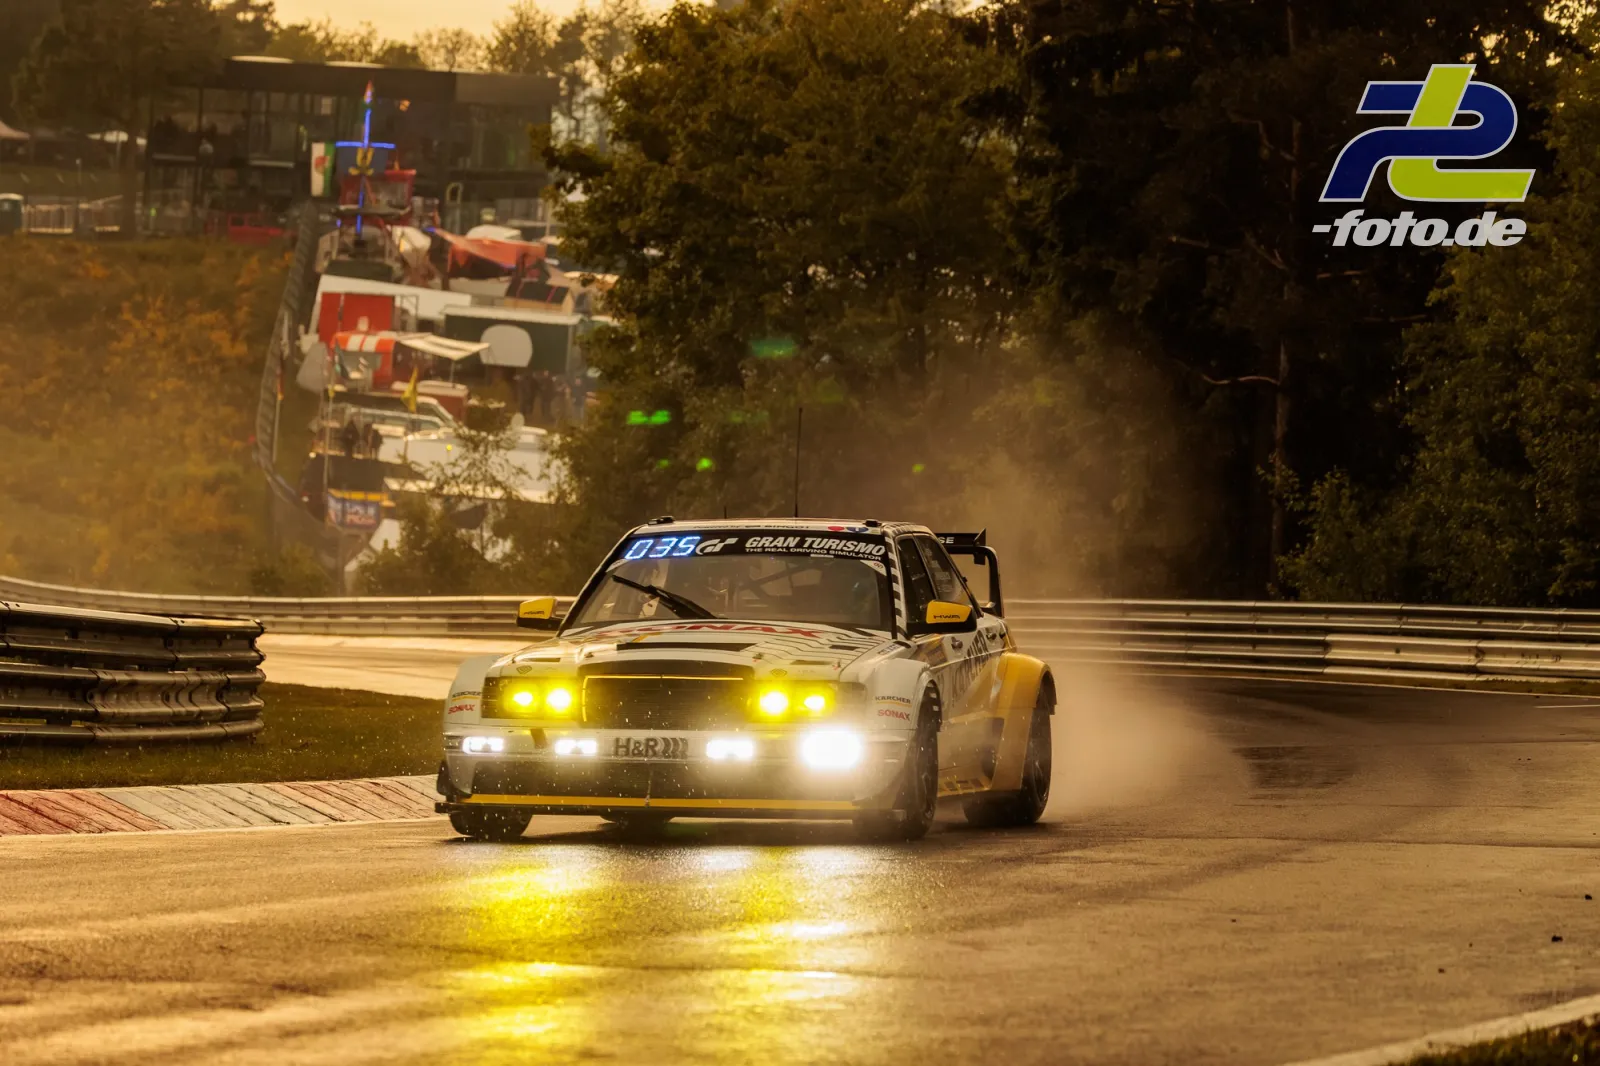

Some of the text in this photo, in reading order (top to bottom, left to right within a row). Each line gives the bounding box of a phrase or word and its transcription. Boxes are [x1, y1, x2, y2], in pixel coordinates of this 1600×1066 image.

[624, 536, 701, 560] 035
[745, 536, 886, 556] GRAN TURISMO
[829, 549, 882, 561] SIMULATOR
[878, 709, 911, 721] SONAX
[614, 737, 660, 758] H&R
